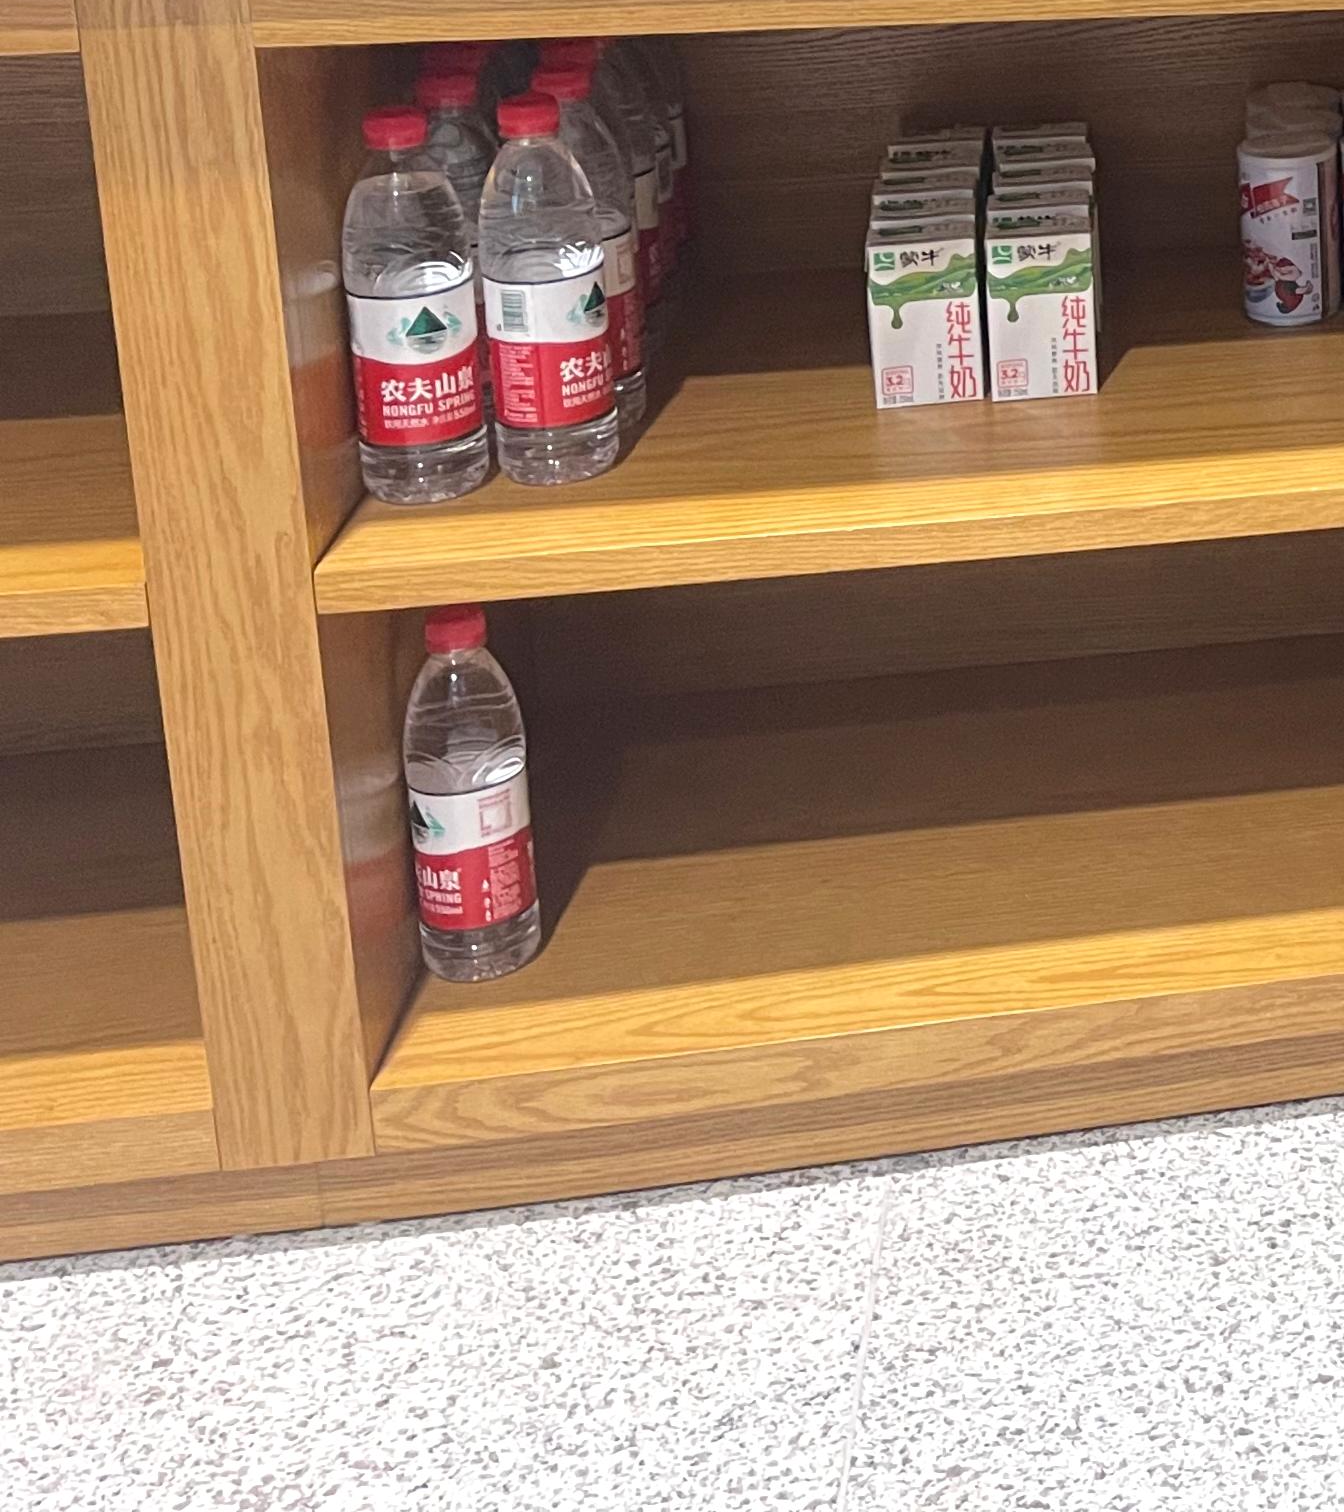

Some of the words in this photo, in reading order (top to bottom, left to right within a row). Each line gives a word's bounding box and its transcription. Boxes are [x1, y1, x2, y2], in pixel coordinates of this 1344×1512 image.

[945, 300, 977, 399] 纯牛奶
[1062, 295, 1091, 392] 纯牛奶
[381, 365, 474, 403] 农夫山泉
[561, 373, 604, 397] NONGFU
[382, 402, 433, 417] NONGFU
